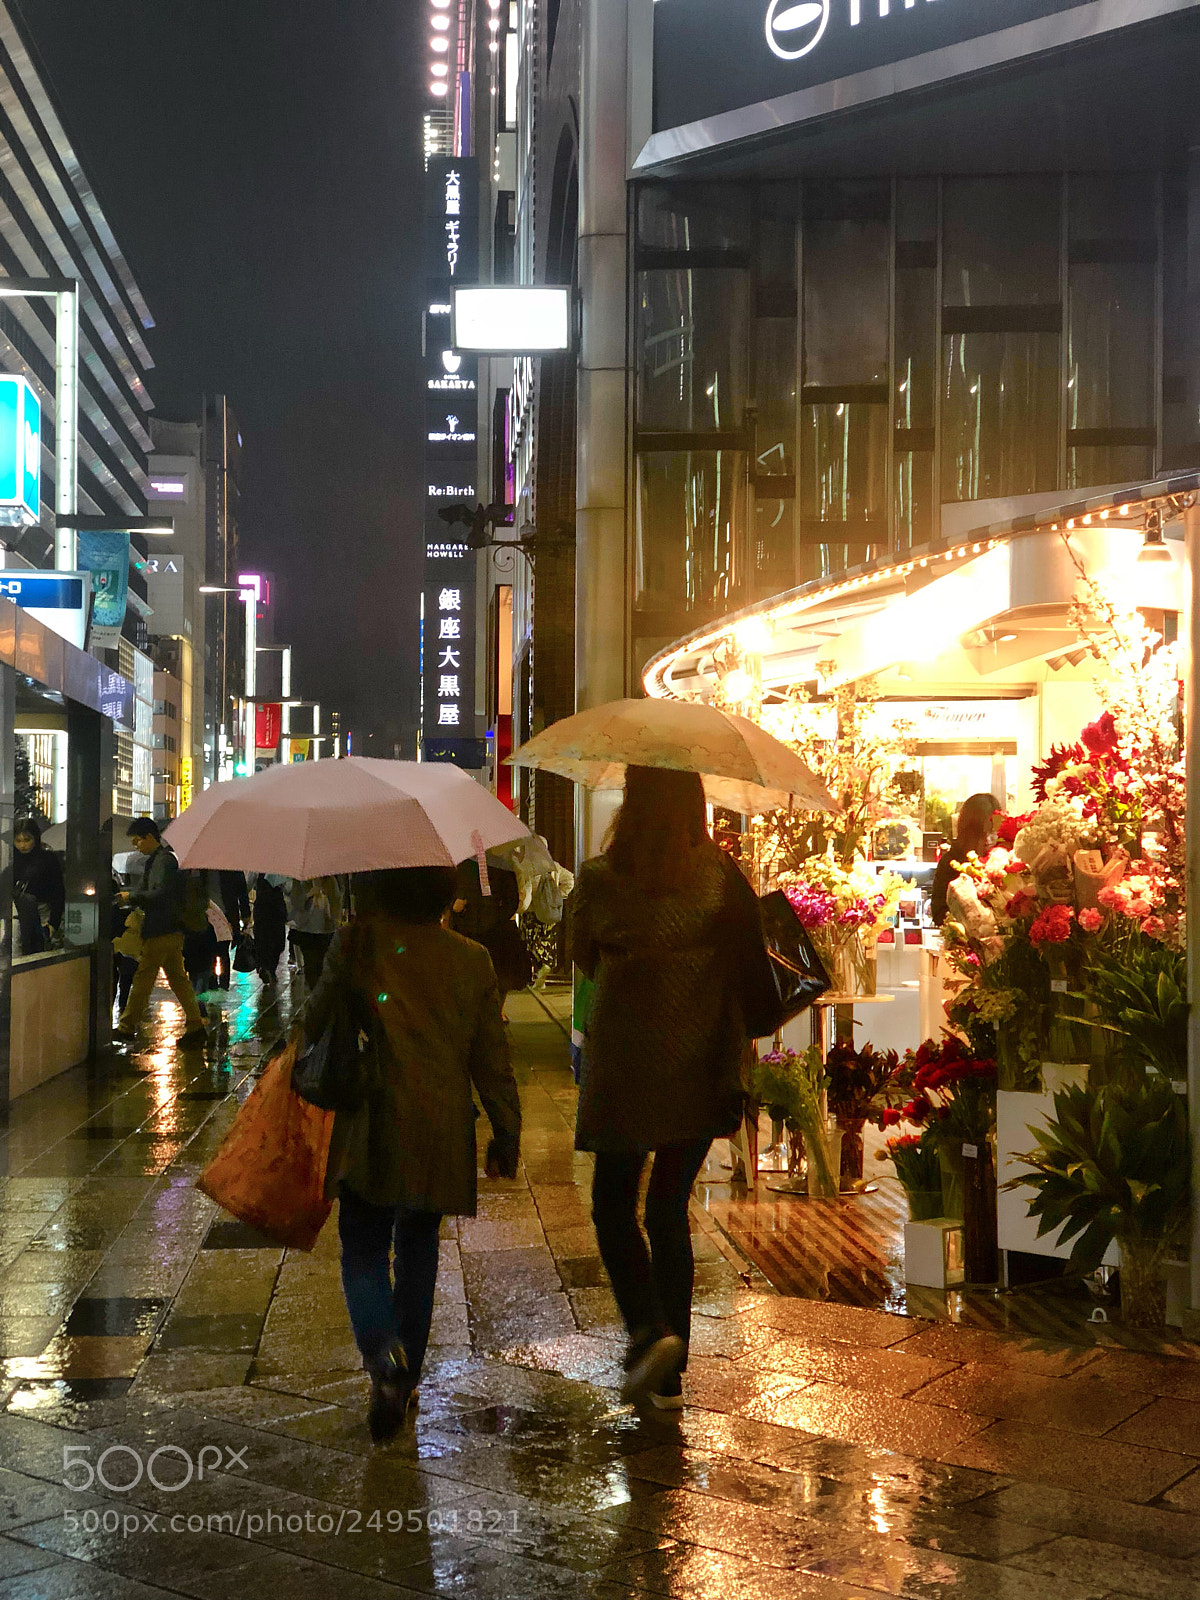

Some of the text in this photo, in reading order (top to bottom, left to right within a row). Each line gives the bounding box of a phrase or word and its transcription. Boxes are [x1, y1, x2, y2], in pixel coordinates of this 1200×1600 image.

[444, 220, 460, 276] ギャラリー
[428, 485, 475, 496] Re:Birth
[426, 543, 473, 551] MARGARE
[437, 587, 462, 725] 銀座大黒屋
